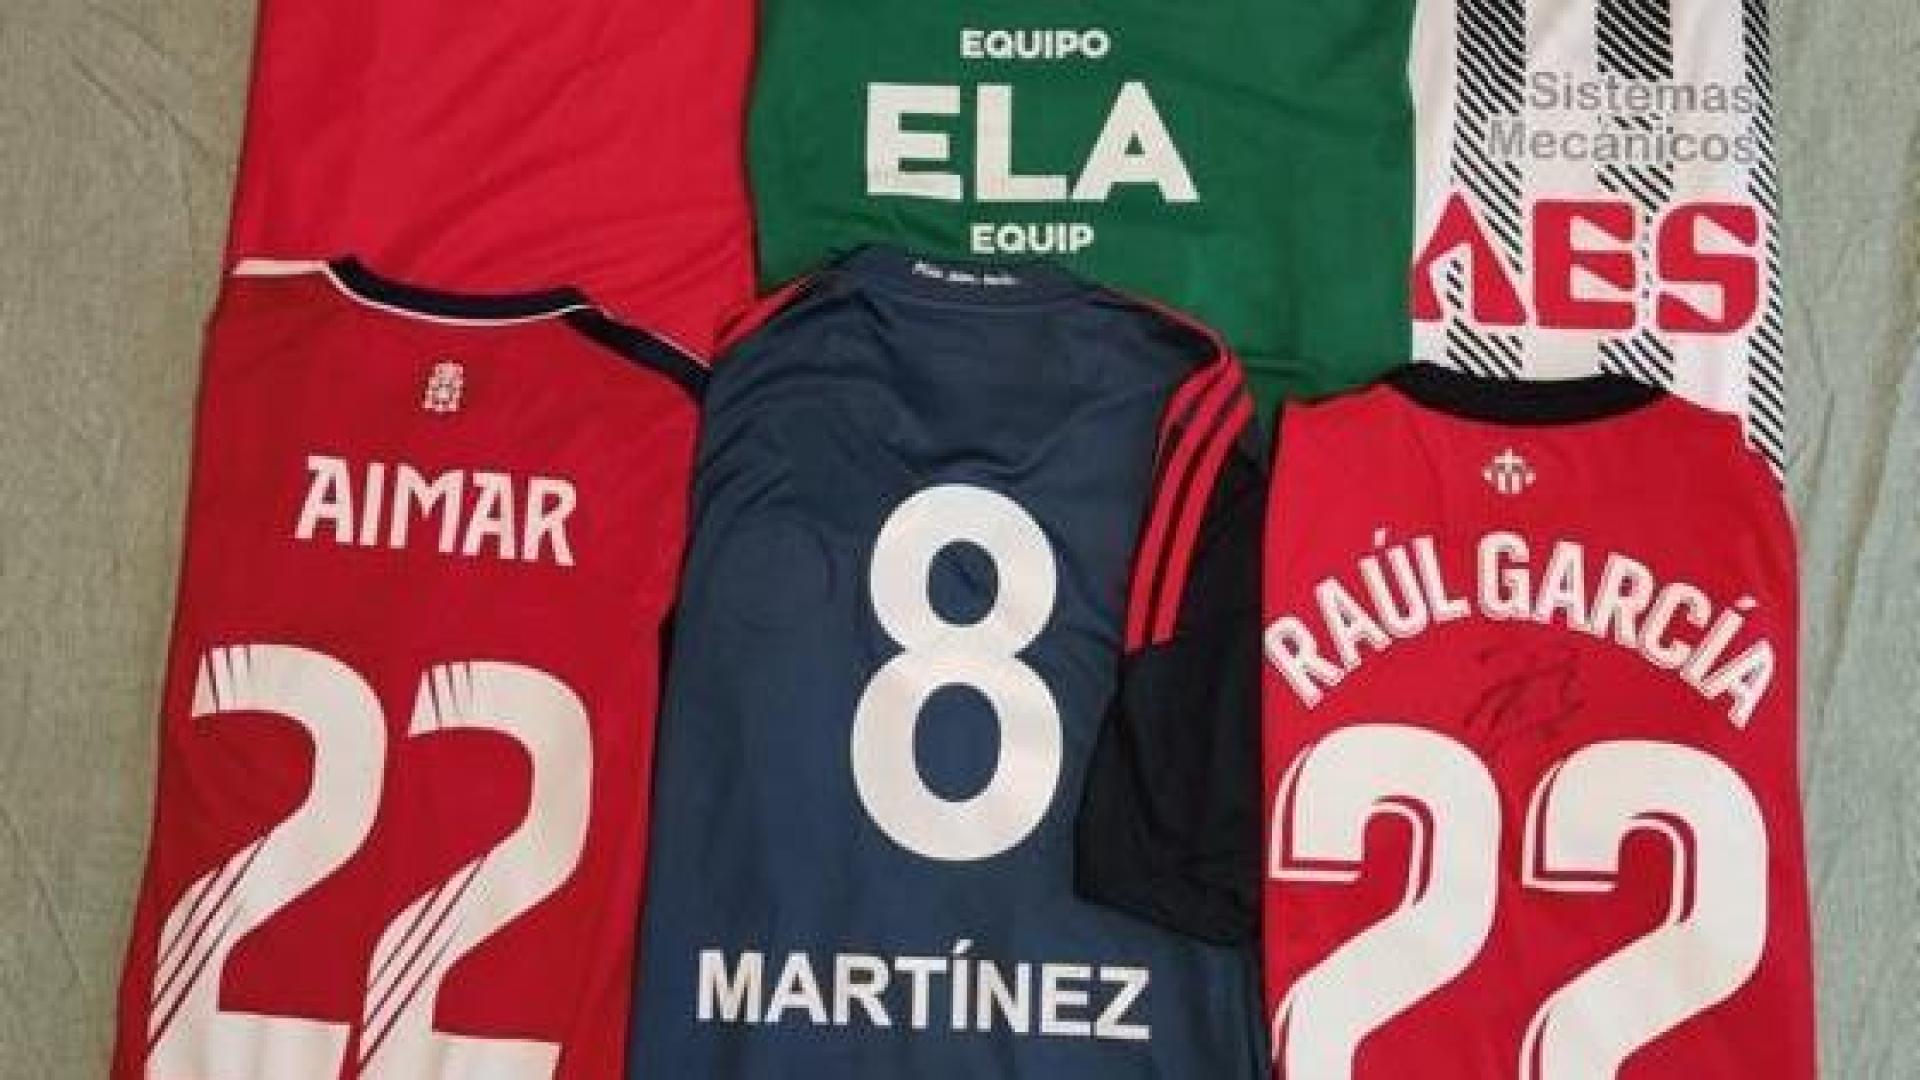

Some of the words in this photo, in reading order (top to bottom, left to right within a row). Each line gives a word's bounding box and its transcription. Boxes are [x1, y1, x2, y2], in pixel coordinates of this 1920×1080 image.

[960, 29, 1111, 58] EQUIPO
[1529, 71, 1755, 114] Sistemas
[866, 81, 1200, 203] ELA
[971, 222, 1093, 254] EQUIP
[294, 454, 577, 566] AIMAR
[850, 483, 1063, 862] 8
[1262, 528, 1471, 709] RAÚL
[1477, 530, 1776, 729] GARCÍA
[144, 643, 594, 1080] 22
[695, 938, 1153, 1040] MARTÍNEZ
